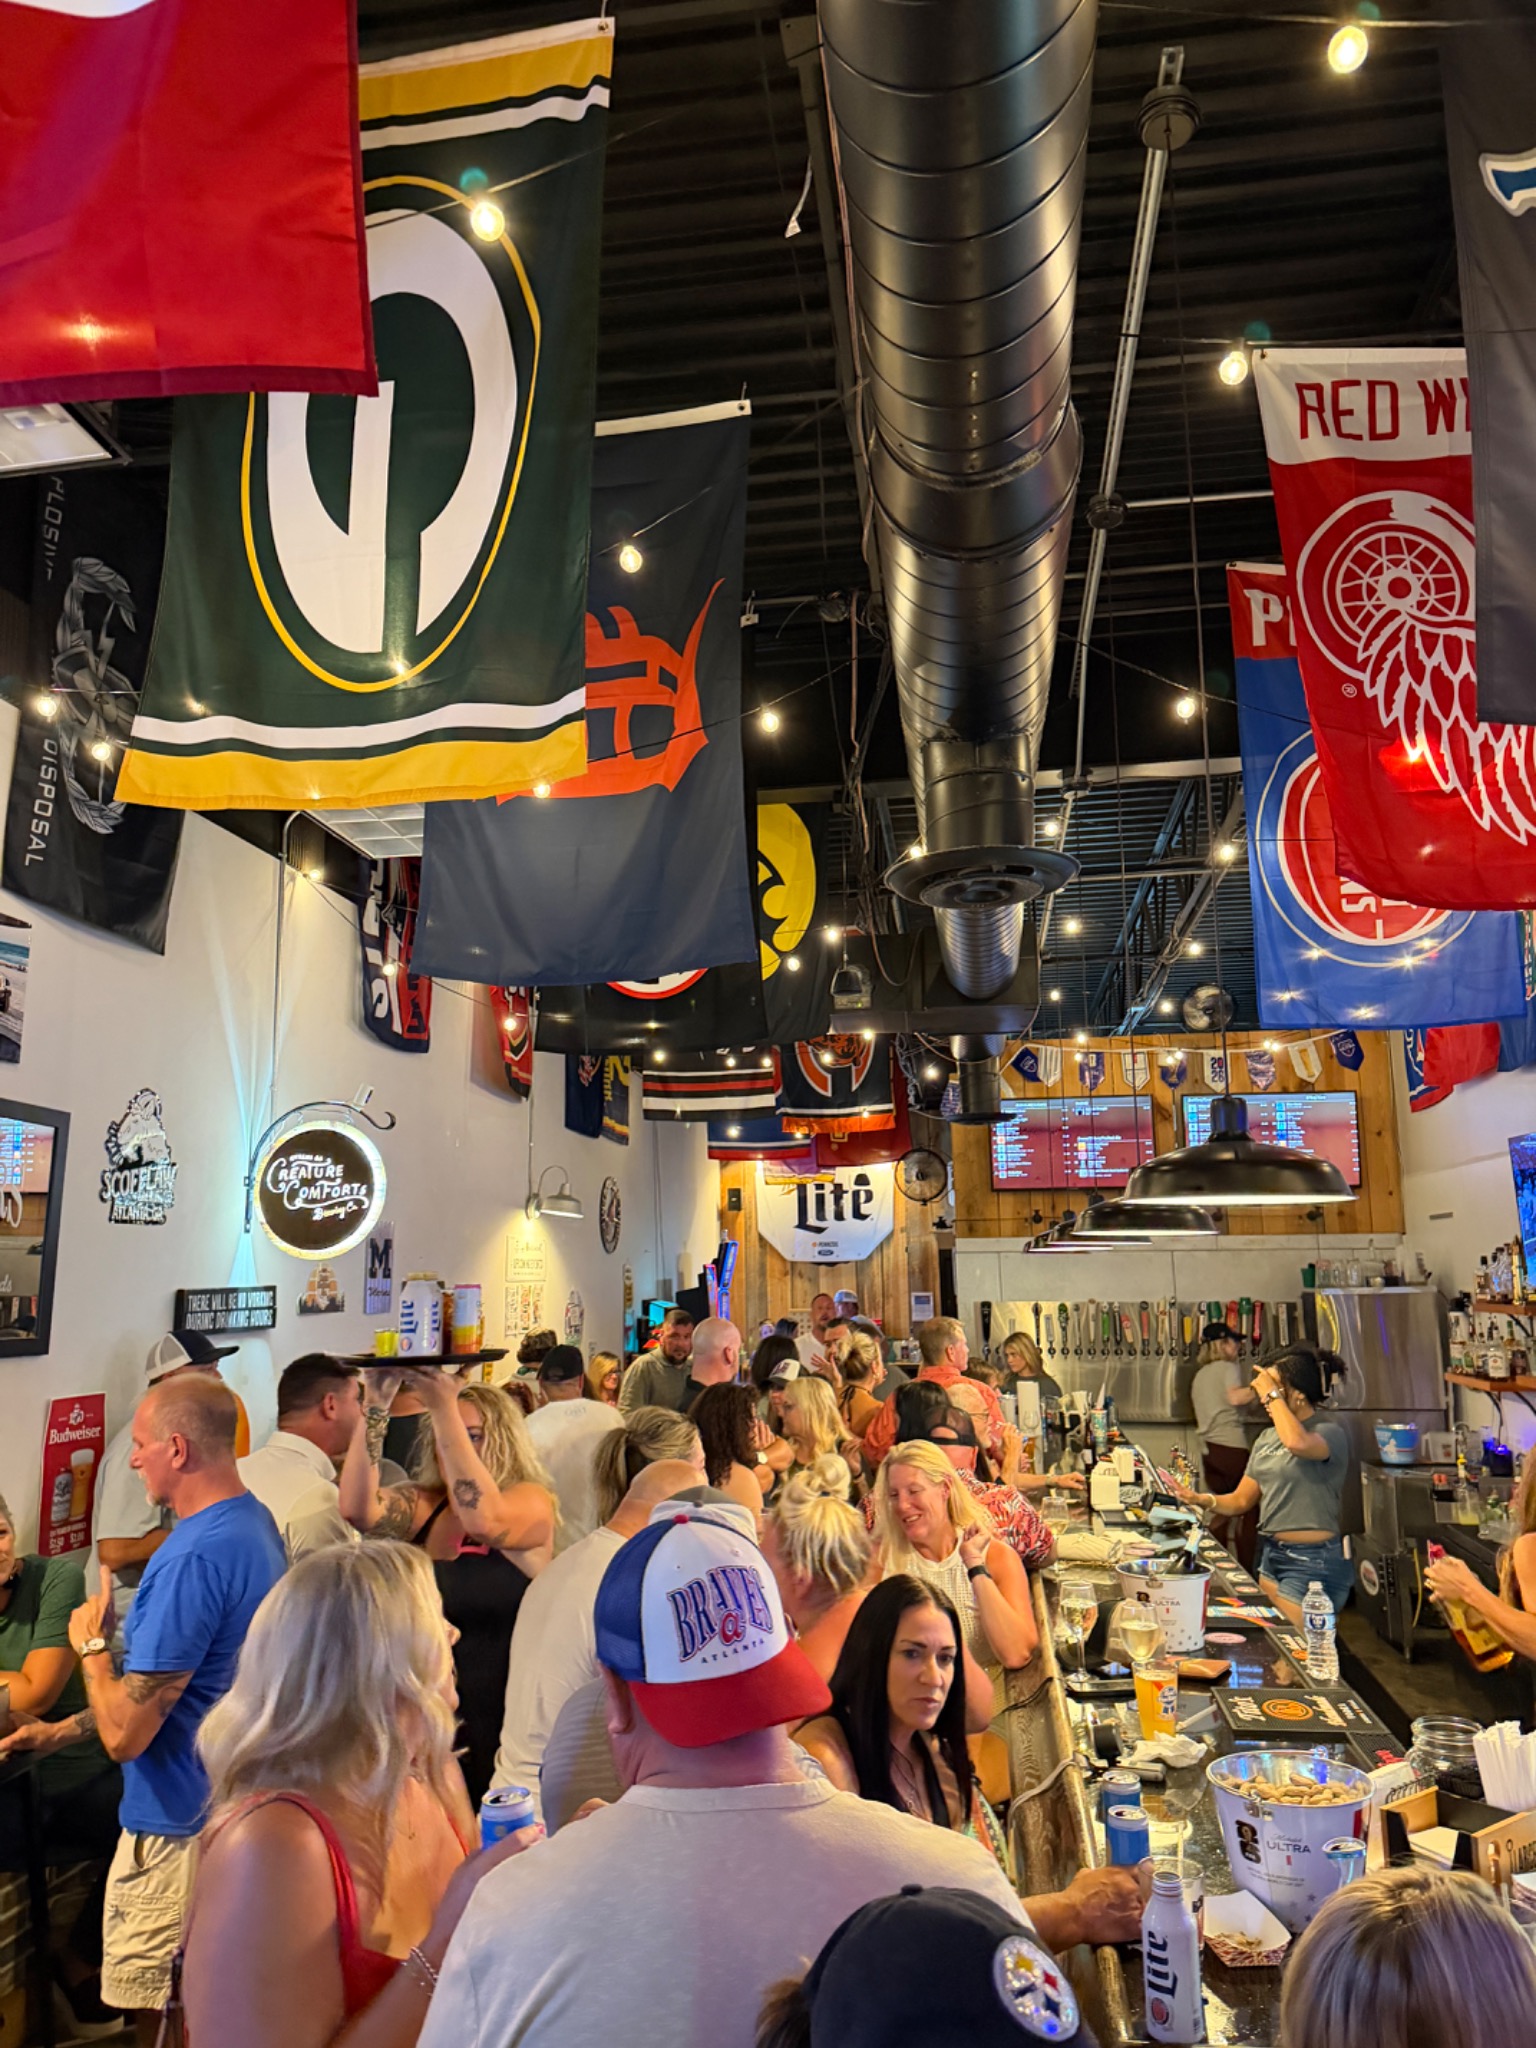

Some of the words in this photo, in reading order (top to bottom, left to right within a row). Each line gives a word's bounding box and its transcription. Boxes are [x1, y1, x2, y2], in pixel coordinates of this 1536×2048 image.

[1294, 380, 1400, 441] RED
[24, 737, 59, 868] DISPOSAL
[99, 1163, 178, 1200] SCOFFLAW
[266, 1157, 345, 1193] CREATURE
[283, 1179, 369, 1210] COMFORTS
[793, 1182, 874, 1235] Lite
[369, 1238, 392, 1279] M
[186, 1312, 215, 1331] DURING
[215, 1310, 250, 1330] DRINKING
[250, 1309, 273, 1326] HOURS
[188, 1294, 211, 1312] THERE
[211, 1293, 227, 1311] WILL
[228, 1292, 238, 1310] BE
[401, 1300, 419, 1335] Lite
[49, 1426, 102, 1445] Budweiser
[666, 1565, 774, 1663] BRAVES
[701, 1637, 765, 1664] ATLANTA
[1266, 1840, 1312, 1854] ULTRA
[1146, 1930, 1178, 2000] Lite
